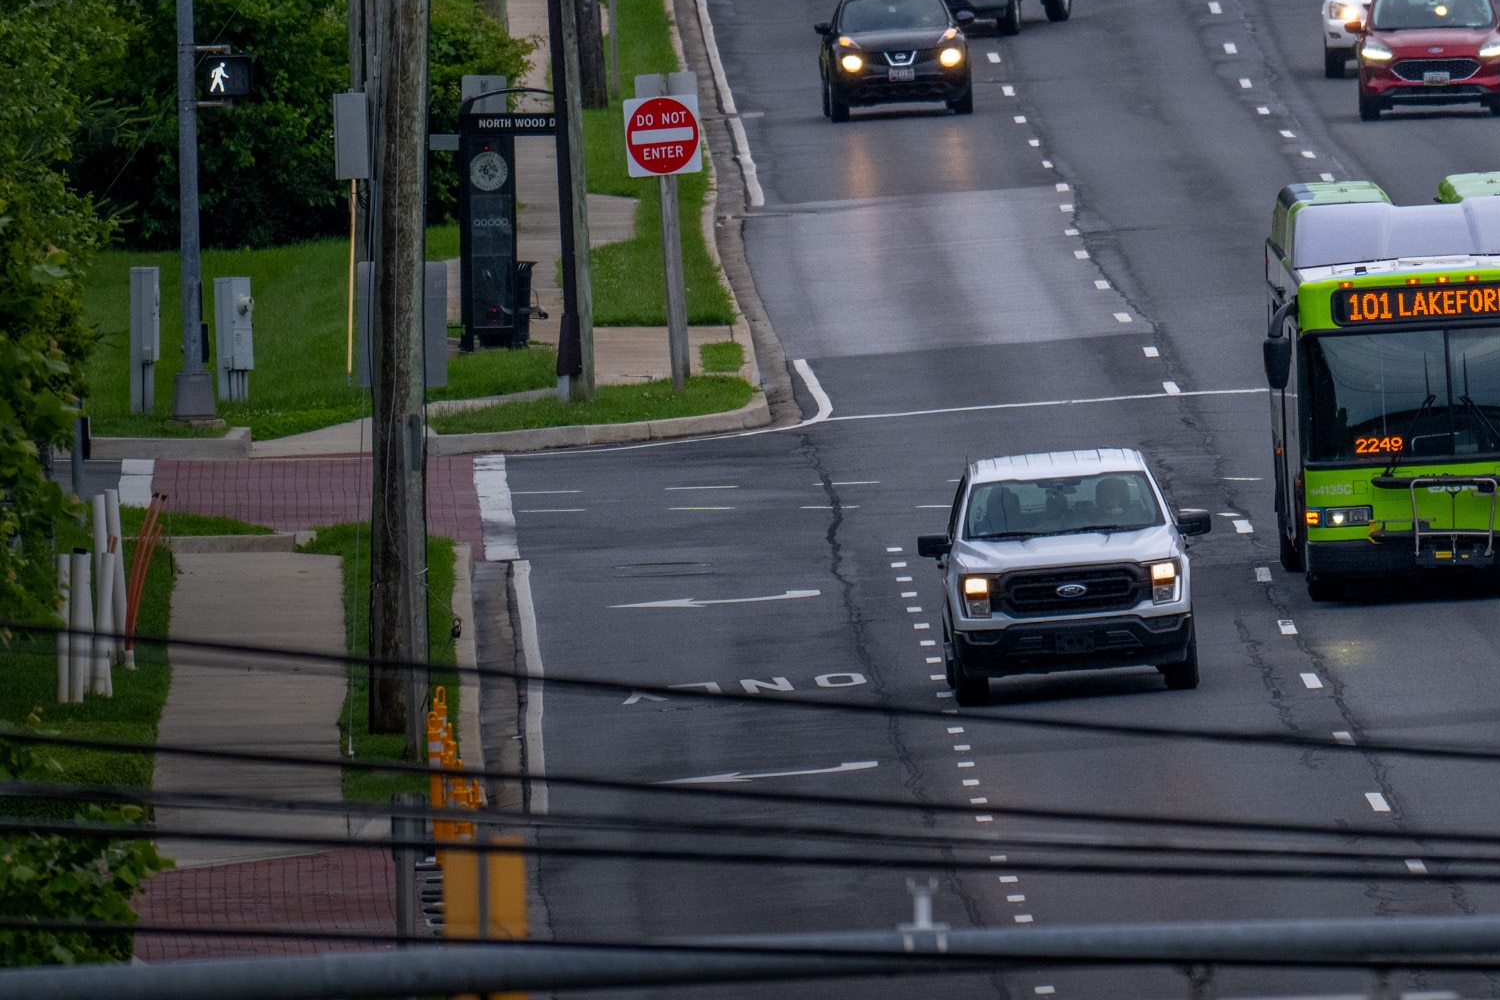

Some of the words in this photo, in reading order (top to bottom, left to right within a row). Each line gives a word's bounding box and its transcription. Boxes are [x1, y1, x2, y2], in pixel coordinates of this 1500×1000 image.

[478, 118, 512, 129] NORTH
[514, 118, 546, 128] WOOD
[636, 114, 654, 127] DO
[661, 111, 686, 125] NOT
[643, 145, 684, 161] ENTER
[1348, 292, 1393, 321] 101
[1355, 436, 1403, 454] 2249
